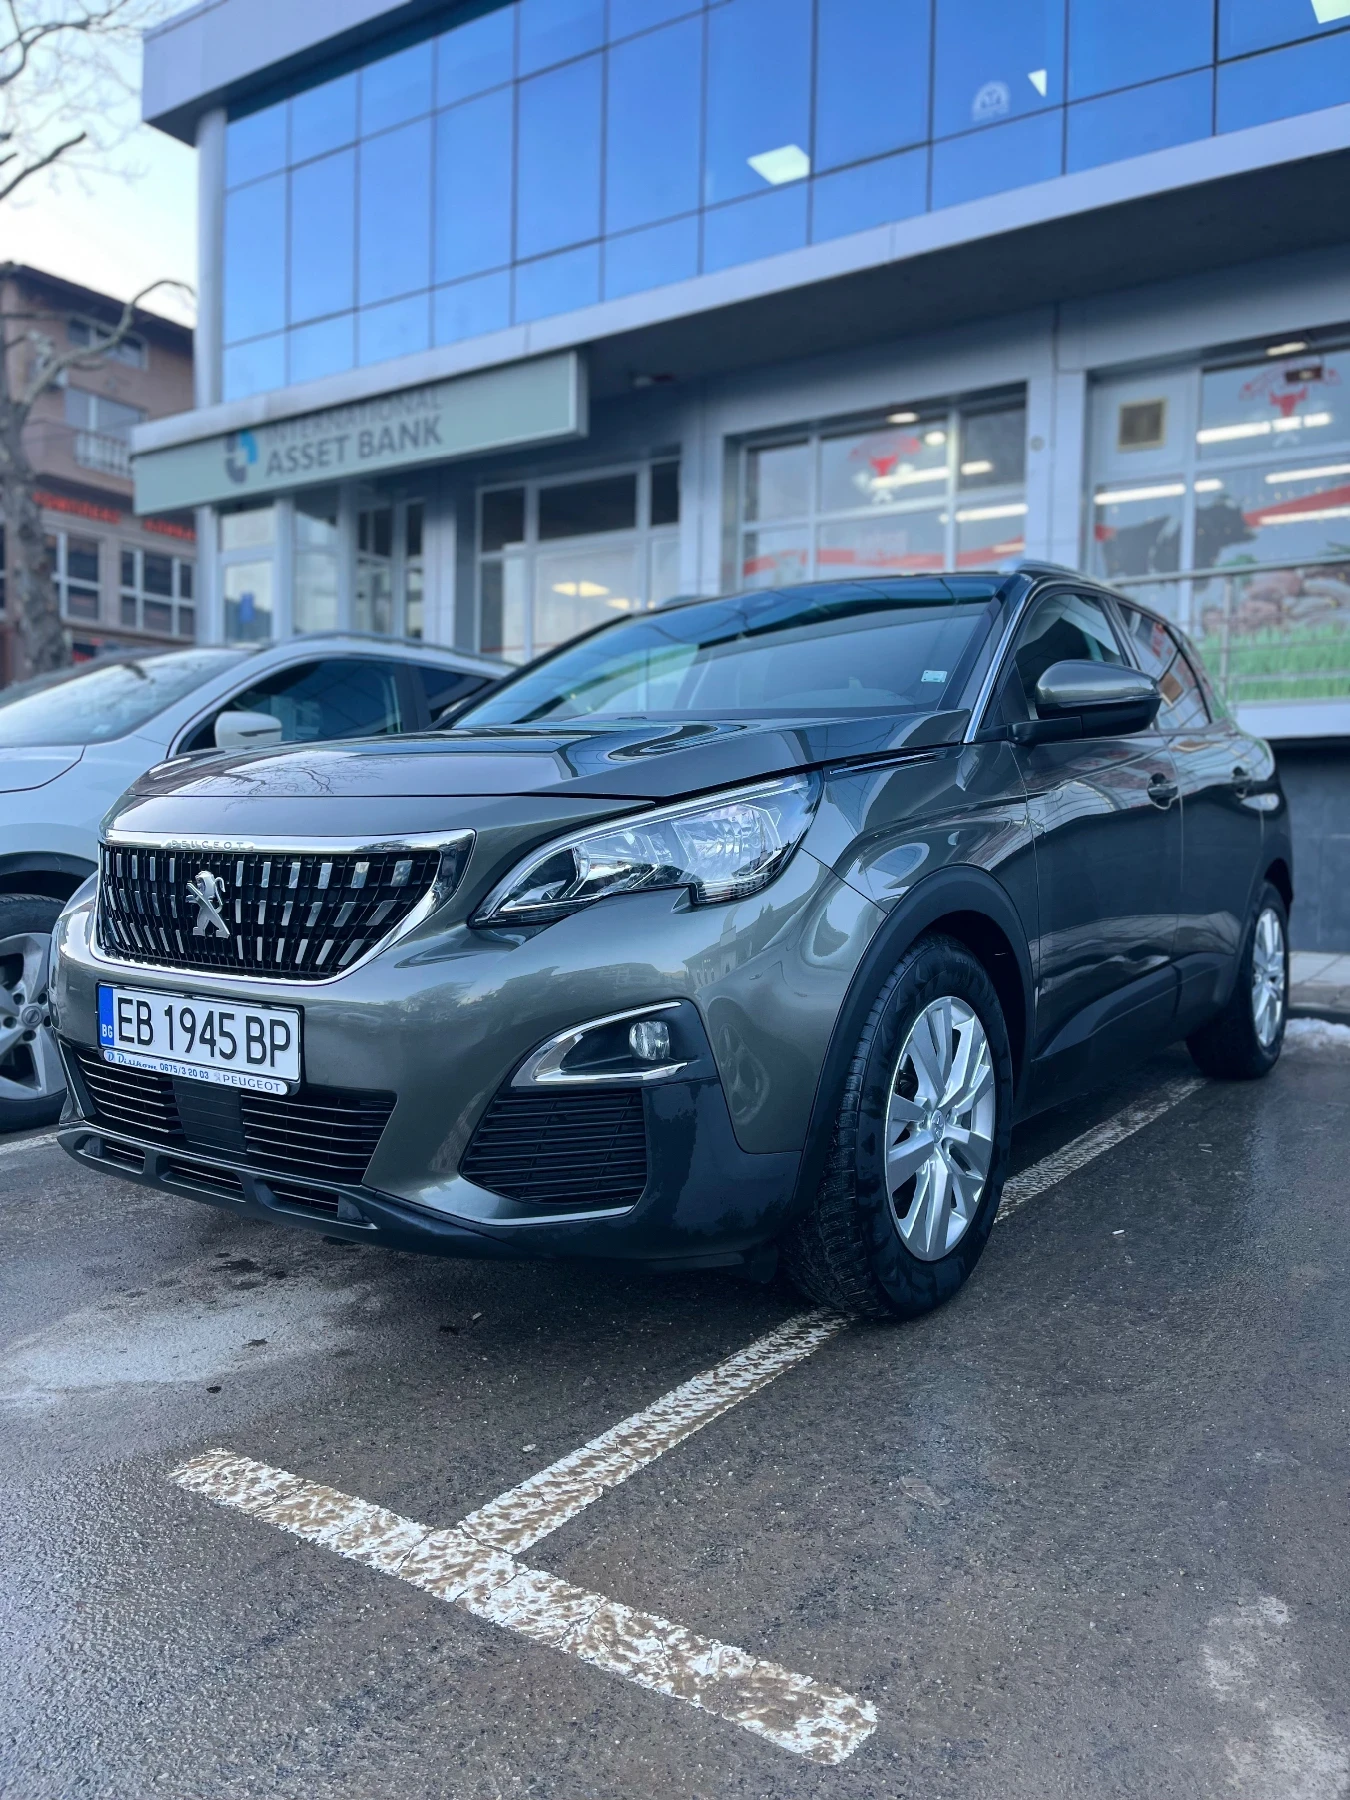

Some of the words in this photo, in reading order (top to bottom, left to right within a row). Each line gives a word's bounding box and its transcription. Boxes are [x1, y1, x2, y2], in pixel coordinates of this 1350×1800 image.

[264, 434, 350, 479] ASSET
[357, 414, 443, 460] BANK
[171, 839, 244, 850] PEUGEOT
[101, 1023, 114, 1039] BG
[117, 996, 155, 1047] EB
[164, 1004, 238, 1061] 1945
[246, 1014, 291, 1068] BP
[160, 1062, 187, 1075] 0675/3
[188, 1068, 198, 1078] 20
[199, 1070, 209, 1080] 03
[223, 1074, 280, 1093] PEUGEOT
